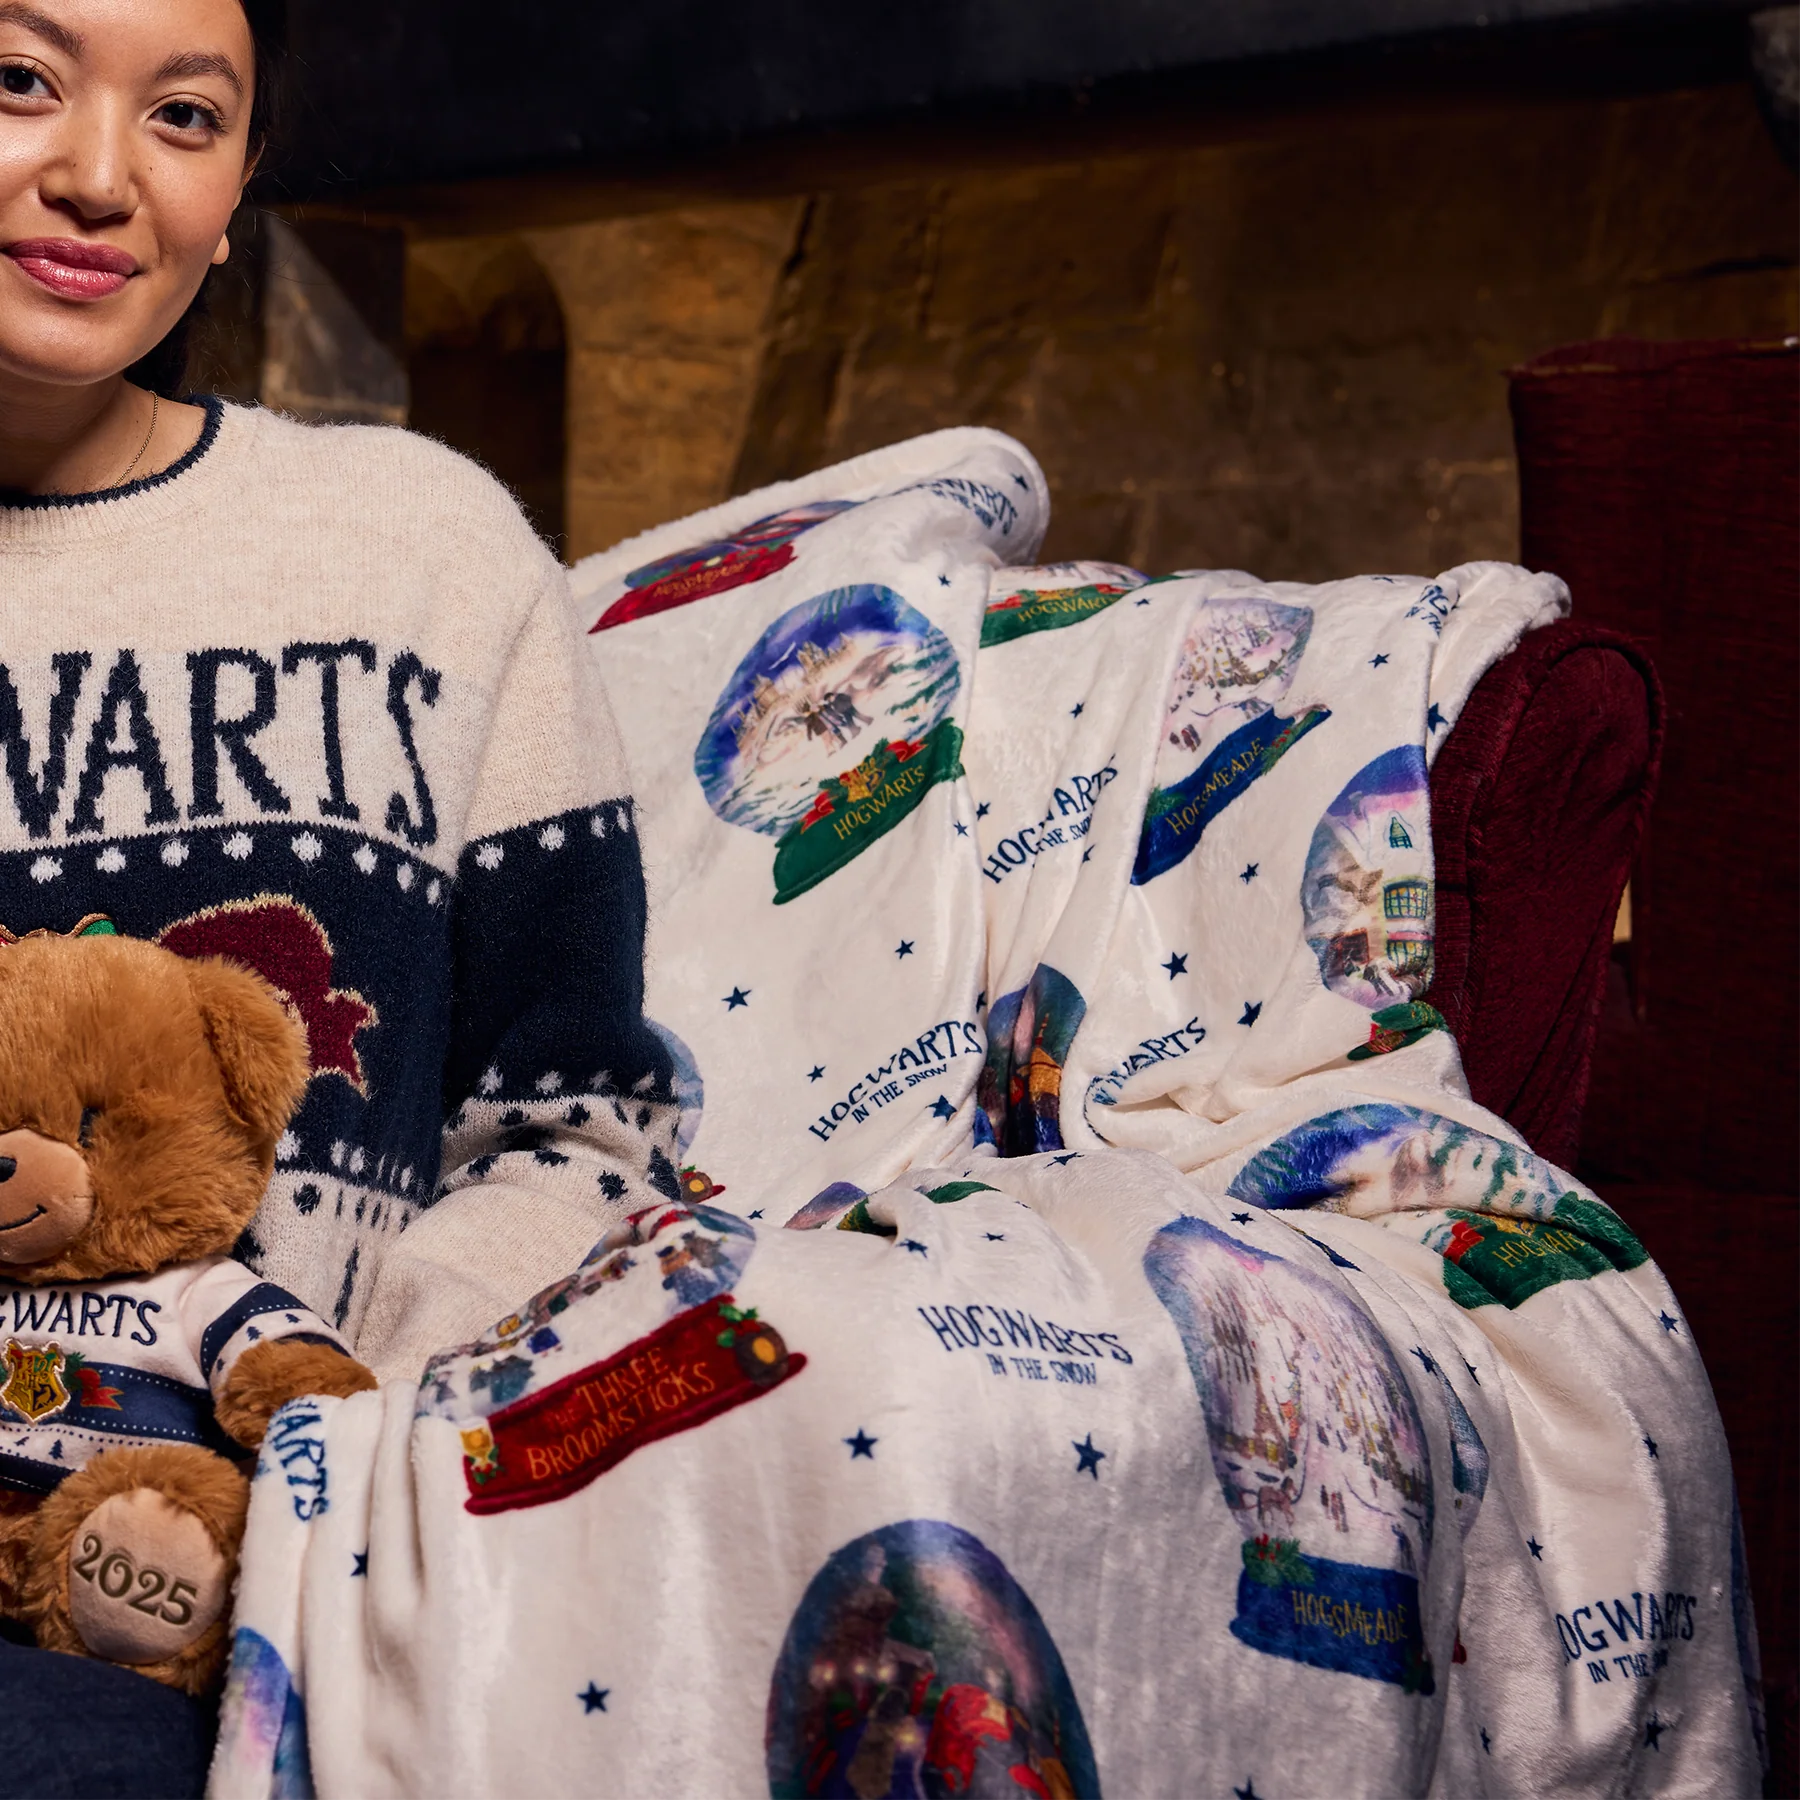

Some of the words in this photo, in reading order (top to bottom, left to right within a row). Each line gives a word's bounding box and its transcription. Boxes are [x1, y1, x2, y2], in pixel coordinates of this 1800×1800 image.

[832, 764, 925, 840] HOGWARTS
[808, 1020, 983, 1142] HOGWARTS
[851, 1104, 870, 1124] IN
[869, 1081, 904, 1109] THE
[905, 1063, 948, 1087] SNOW
[0, 1290, 162, 1346] WARTS
[917, 1305, 1133, 1365] HOGWARTS
[575, 1347, 669, 1414] THREE
[986, 1353, 1008, 1376] IN
[1009, 1357, 1048, 1381] THE
[1049, 1360, 1096, 1385] SNOW
[527, 1361, 715, 1480] BROOMSTICKS
[74, 1535, 197, 1627] 2025
[1292, 1590, 1408, 1645] HOGSMEADE
[1555, 1591, 1697, 1661] OGWARTS
[1587, 1659, 1611, 1683] IN
[1613, 1653, 1650, 1678] THE
